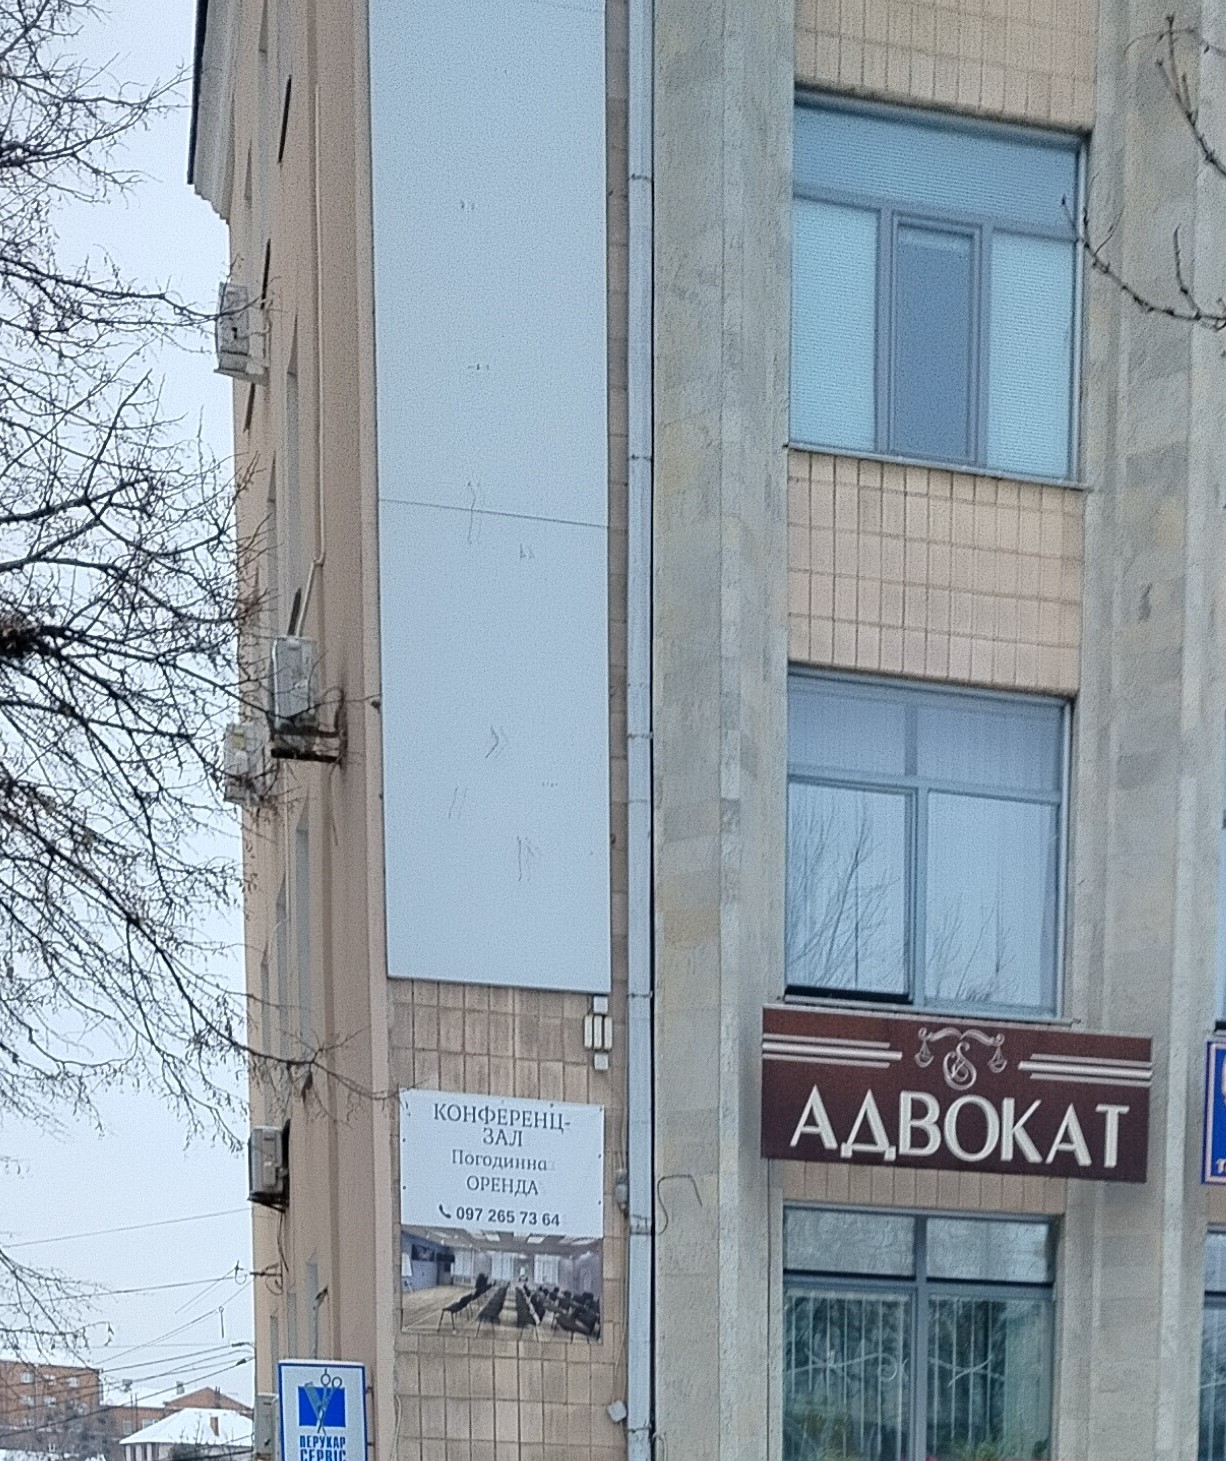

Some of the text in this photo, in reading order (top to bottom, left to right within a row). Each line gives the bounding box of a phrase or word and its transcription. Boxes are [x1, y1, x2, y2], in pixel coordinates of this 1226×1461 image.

[433, 1103, 571, 1133] КОНФЕРЕНЦ-
[790, 1085, 1130, 1168] АДВОКАТ
[483, 1128, 523, 1147] ЗАЛ
[452, 1149, 547, 1171] Погодинна
[466, 1175, 539, 1197] ОРЕНДА
[456, 1206, 560, 1227] 097 265 73 64
[300, 1435, 346, 1449] ПЕРУКАР
